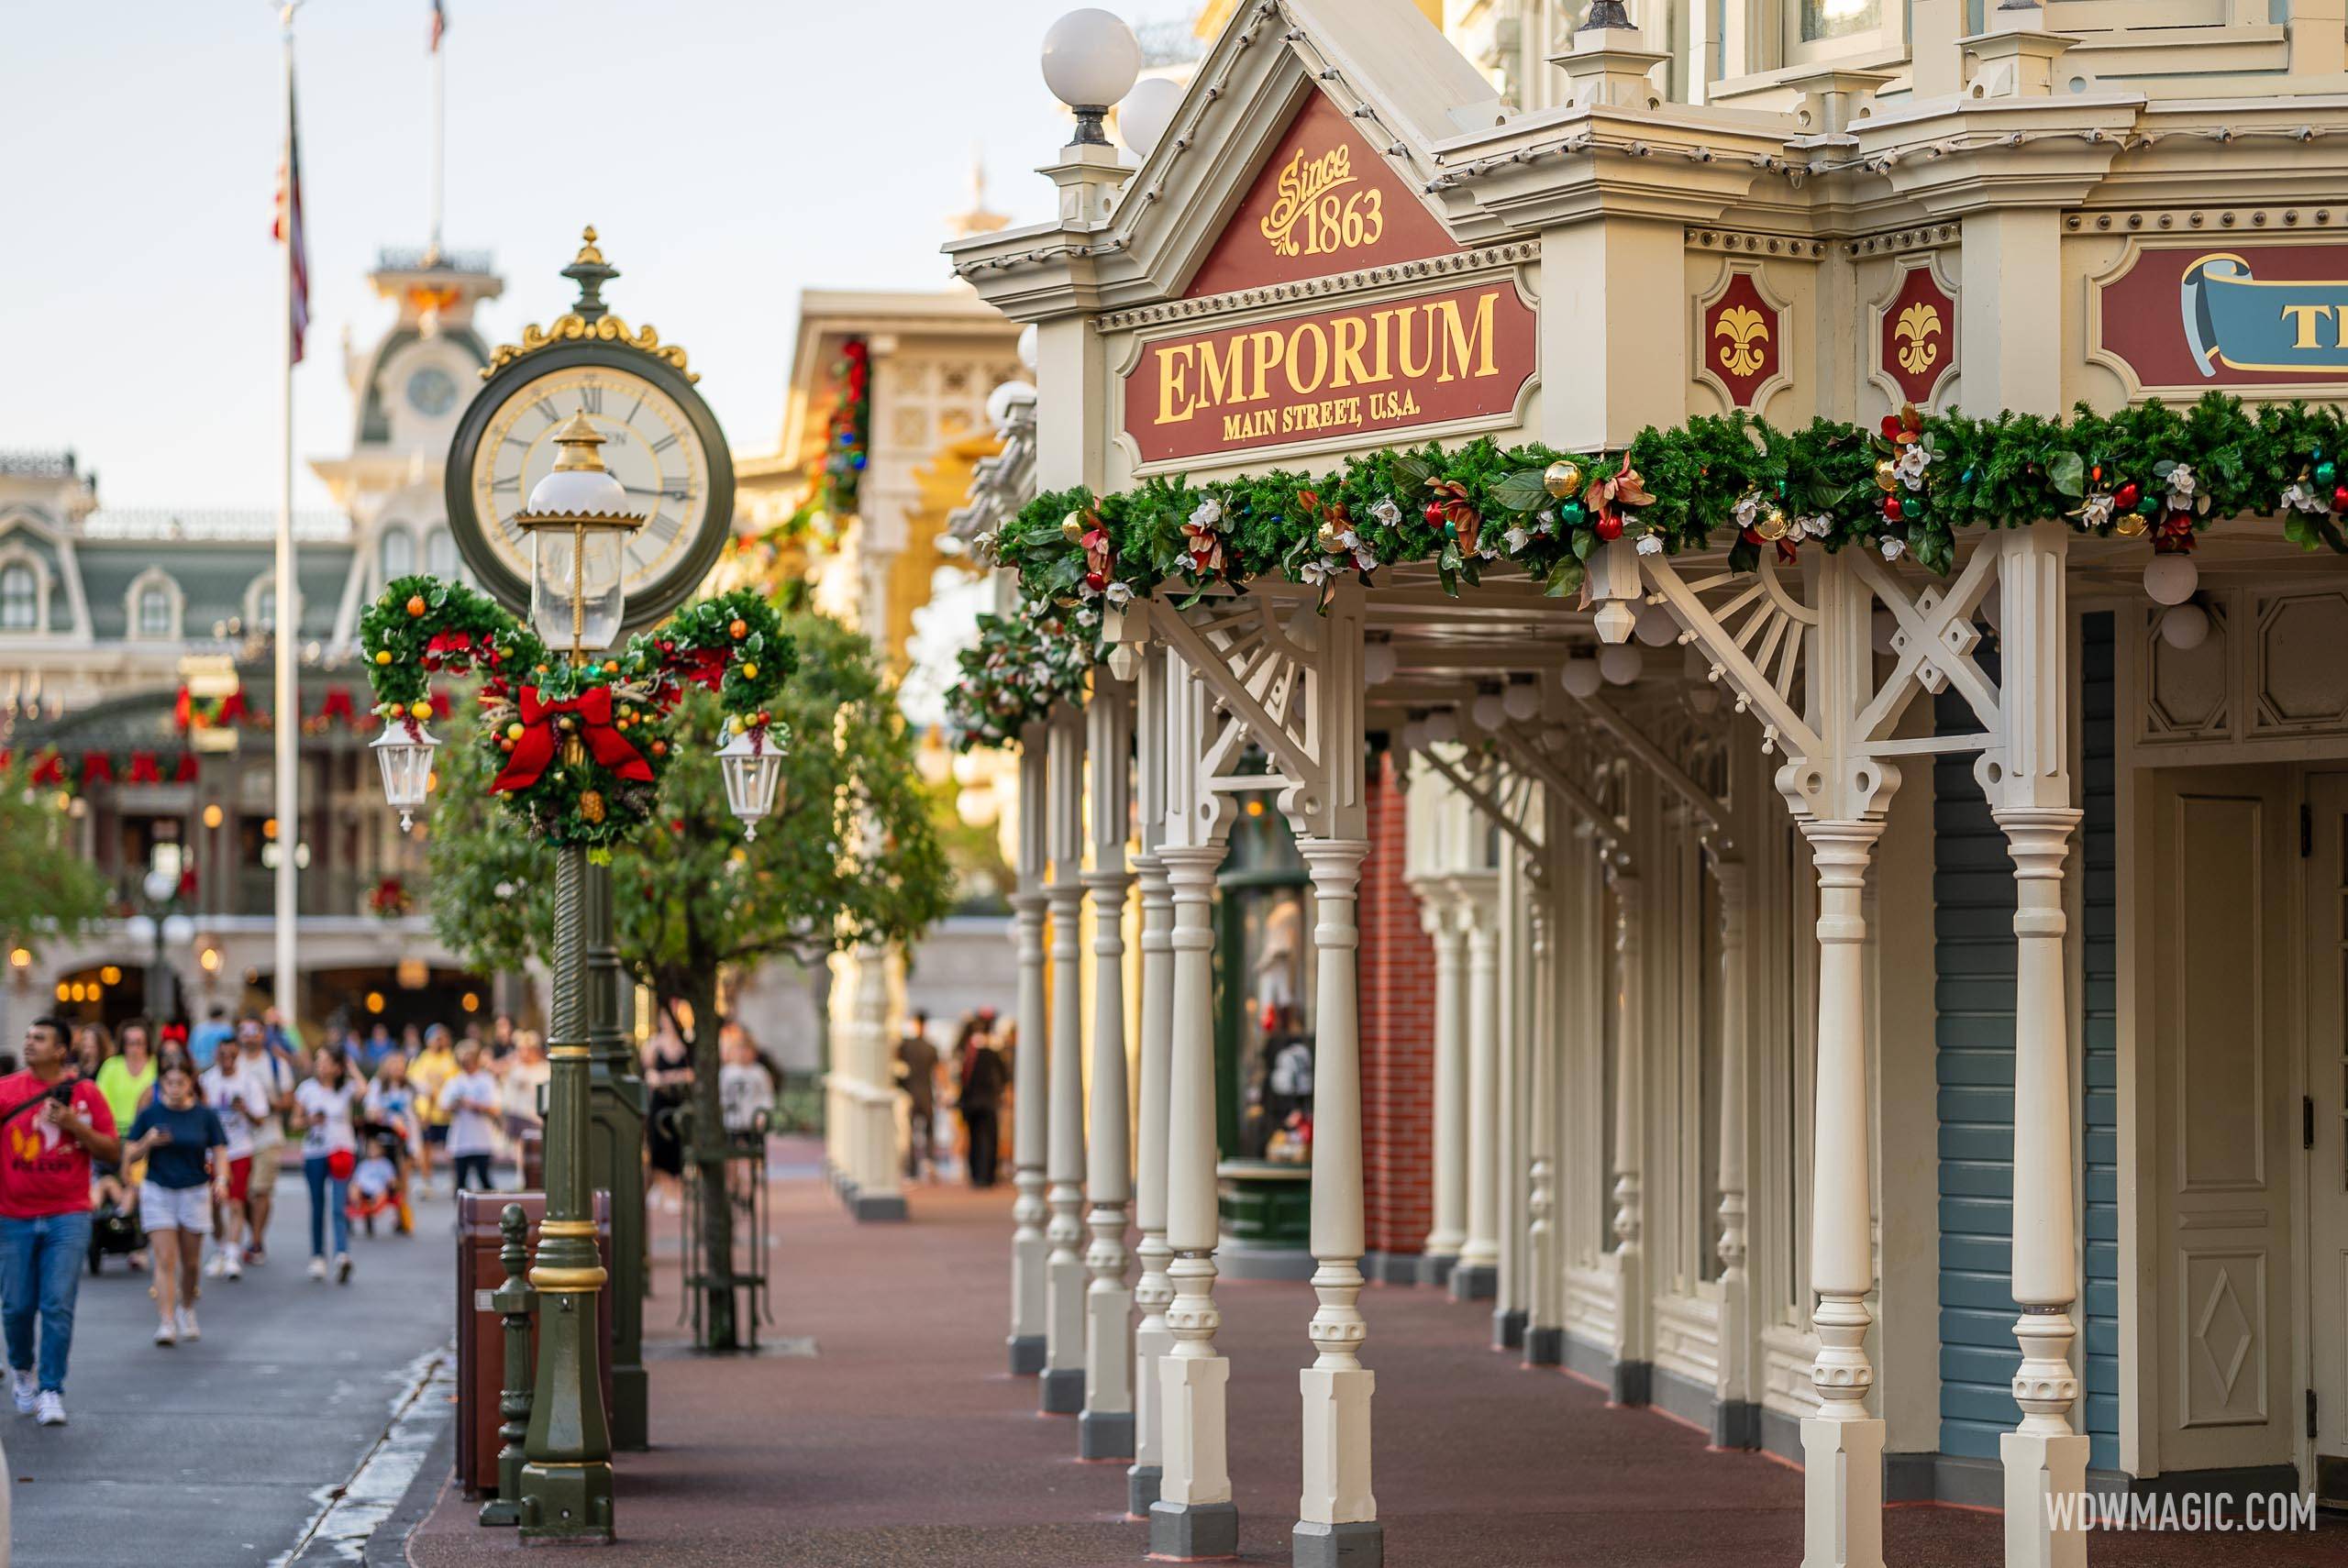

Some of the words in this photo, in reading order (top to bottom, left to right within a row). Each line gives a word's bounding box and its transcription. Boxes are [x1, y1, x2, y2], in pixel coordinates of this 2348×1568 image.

[1269, 144, 1351, 228] Since
[1303, 188, 1383, 255] 1863
[1153, 292, 1501, 425] EMPORIUM
[1223, 409, 1278, 441] MAIN
[1282, 396, 1363, 434] STREET,
[1369, 389, 1421, 420] U.S.A.
